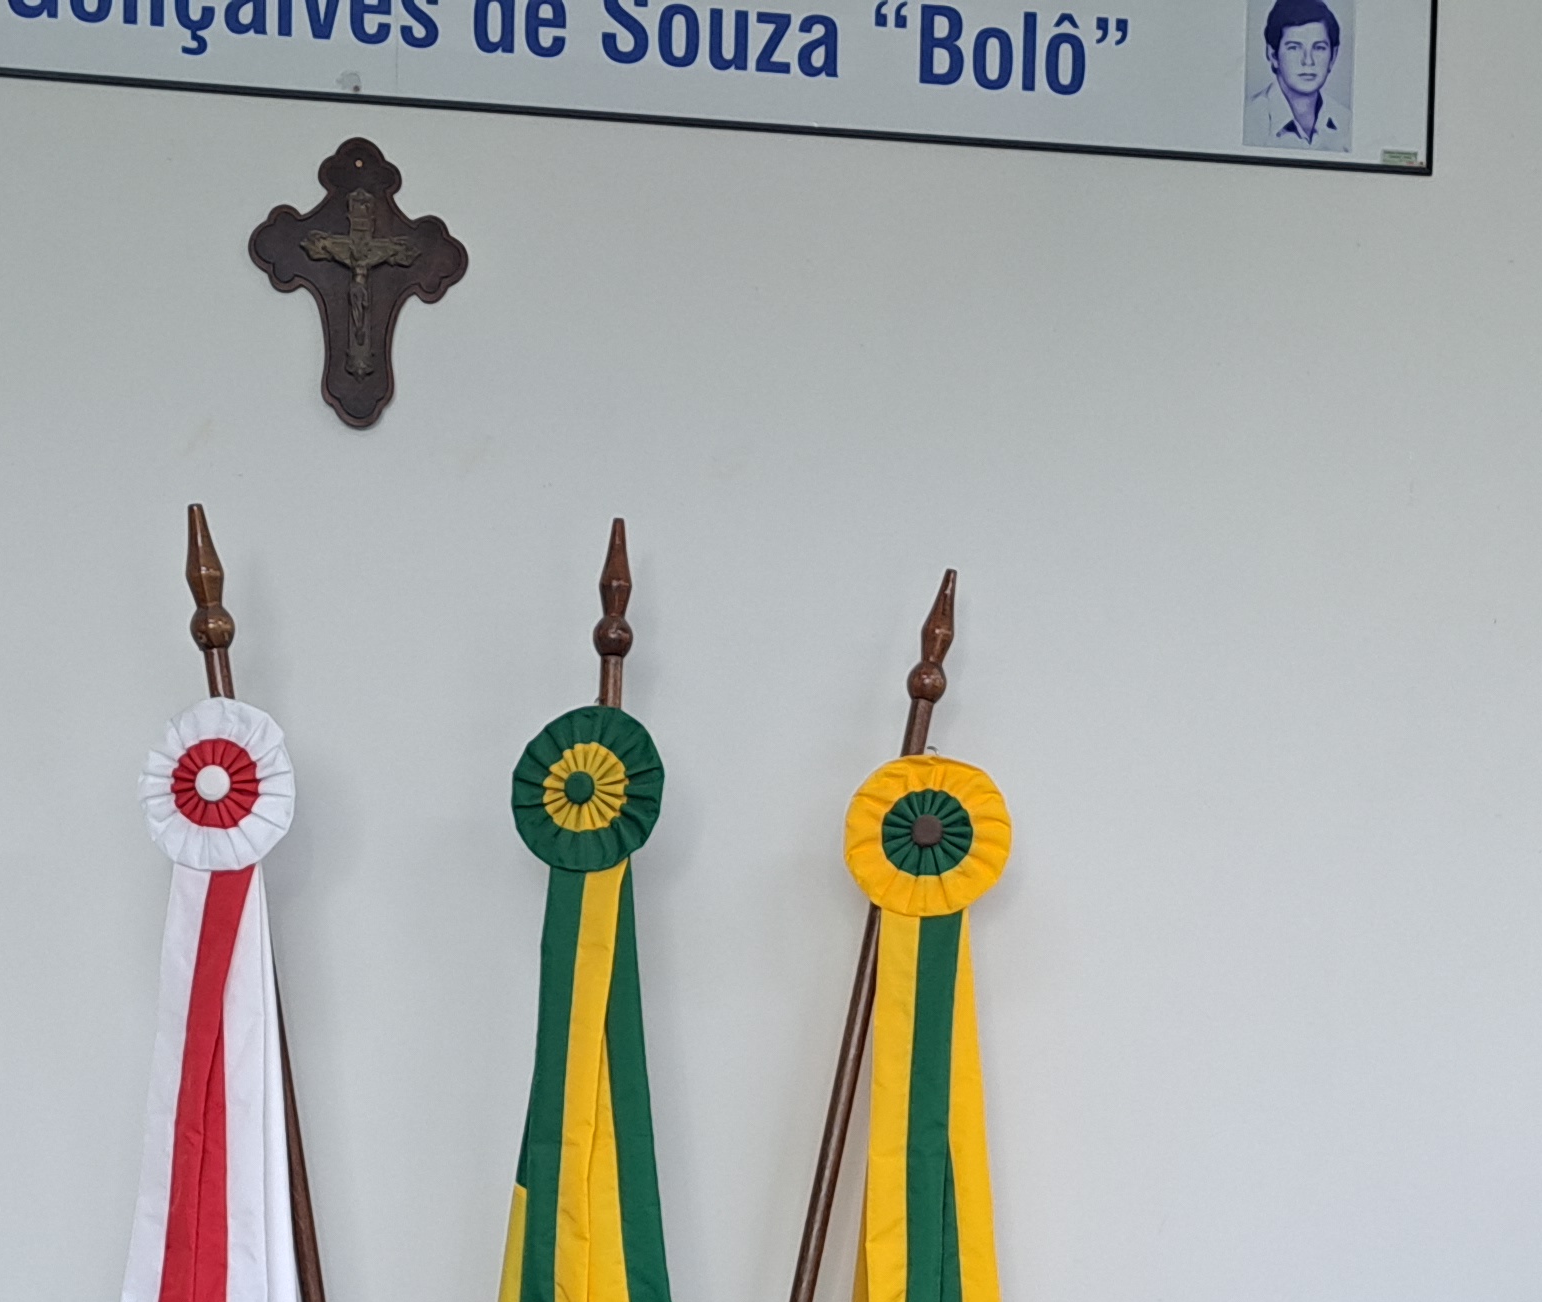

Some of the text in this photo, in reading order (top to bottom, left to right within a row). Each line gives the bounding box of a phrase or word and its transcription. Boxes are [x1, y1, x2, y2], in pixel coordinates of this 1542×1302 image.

[7, 0, 440, 55] çaves
[472, 0, 568, 58] de
[600, 0, 840, 79] Souza
